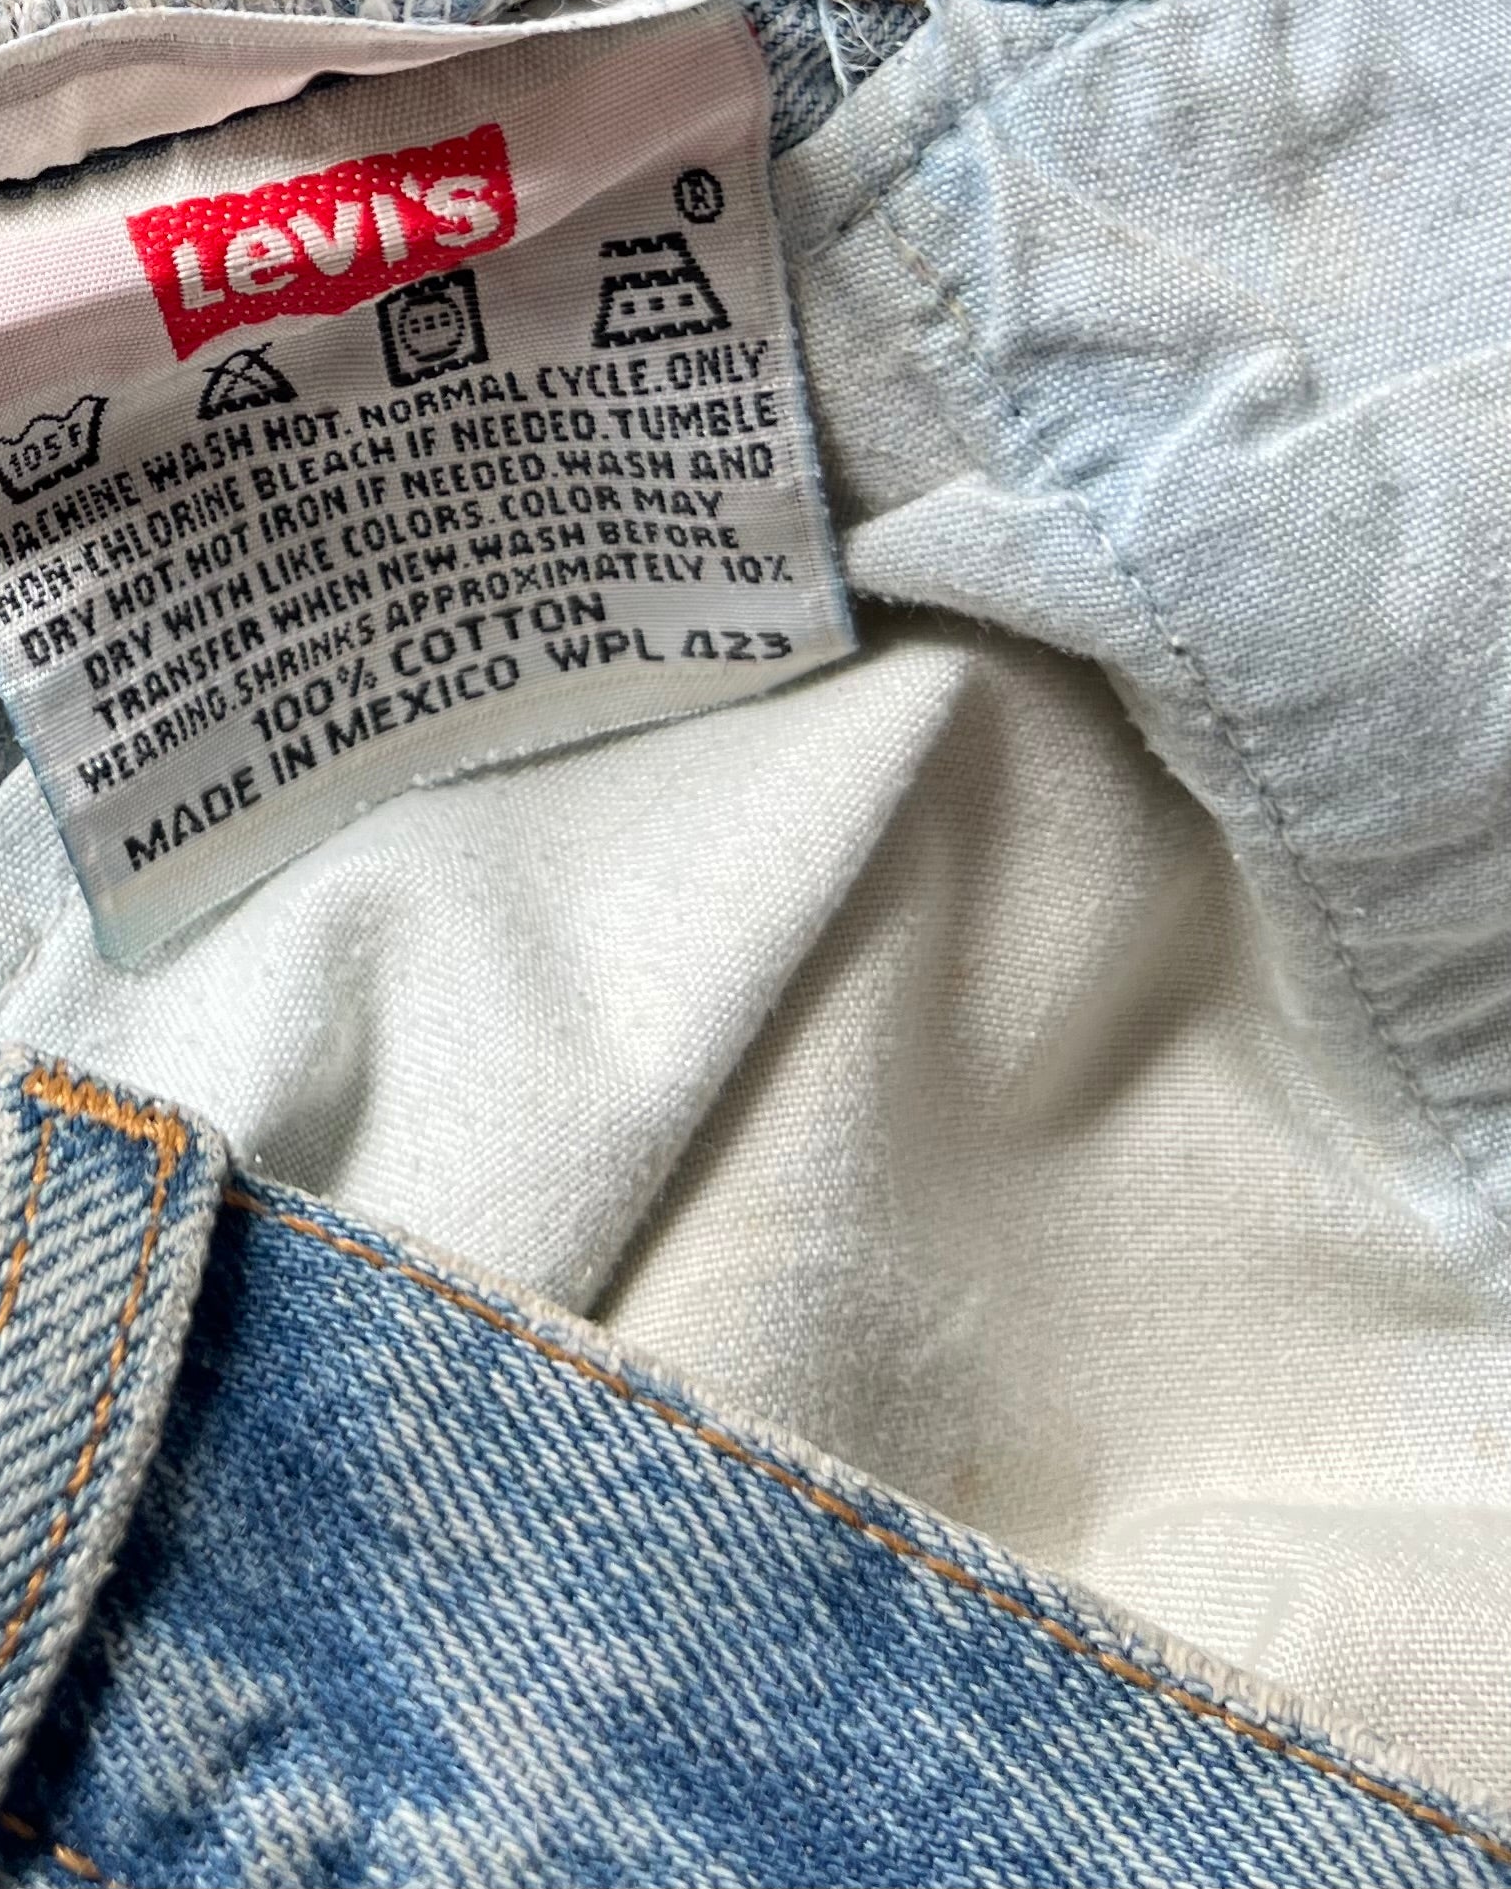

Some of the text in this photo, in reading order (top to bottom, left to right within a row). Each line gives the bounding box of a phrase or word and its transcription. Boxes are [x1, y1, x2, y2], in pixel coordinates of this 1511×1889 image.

[172, 173, 501, 310] Levi's
[142, 422, 254, 492] WASH
[359, 372, 527, 429] NORMAL
[251, 436, 396, 501] BLEACH
[406, 427, 436, 459] IF
[20, 599, 96, 668] DRY
[258, 485, 348, 544] IRON
[356, 476, 386, 509] IF
[690, 442, 774, 480] AND
[83, 621, 152, 690] DRY
[162, 572, 253, 640] WITH
[257, 537, 334, 594] LIKE
[632, 487, 724, 518] MAY
[93, 616, 265, 731] TRANSFER
[269, 568, 373, 634] WHEN
[597, 519, 739, 549] BEFORE
[386, 552, 704, 633] APPROXIMATELY
[720, 554, 793, 584] 10%
[252, 591, 606, 742] 100% COTTON
[123, 765, 262, 871] MADE
[269, 734, 318, 786] IN
[324, 654, 520, 756] MEXICO
[544, 628, 665, 672] WPL
